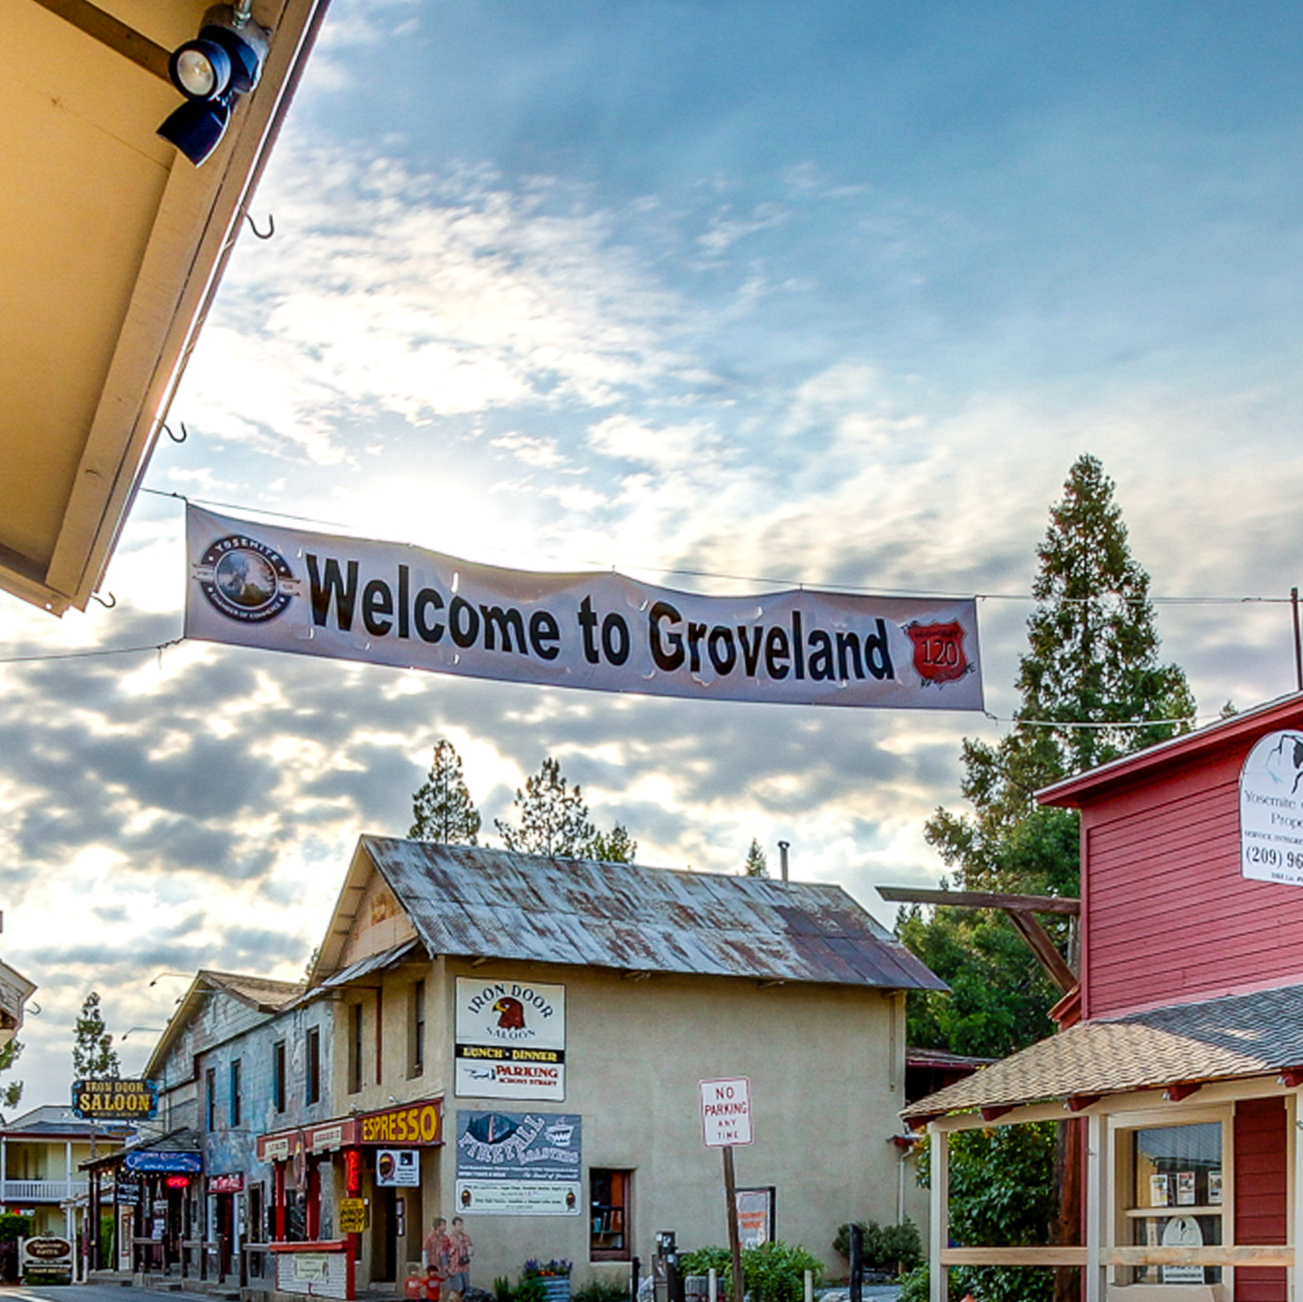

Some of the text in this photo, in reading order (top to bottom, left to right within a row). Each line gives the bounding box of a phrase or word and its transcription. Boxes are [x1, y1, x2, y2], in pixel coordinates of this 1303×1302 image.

[214, 538, 280, 561] YOSEMITE
[306, 554, 894, 680] Welcome to Groveland
[921, 640, 960, 667] 120
[1244, 789, 1296, 810] Yosemite
[1246, 845, 1282, 868] (209)
[468, 984, 553, 1018] IRON DOOR
[486, 1027, 536, 1040] SALOON
[463, 1047, 557, 1061] LUNCH DINNER
[496, 1065, 558, 1078] PARKING
[85, 1082, 144, 1092] IRON DOOR
[716, 1087, 734, 1100] NO
[79, 1094, 150, 1111] SALOON
[705, 1101, 747, 1116] PARKING
[362, 1105, 437, 1141] ESPRESSO
[718, 1119, 736, 1127] ANY
[717, 1131, 738, 1139] TIME
